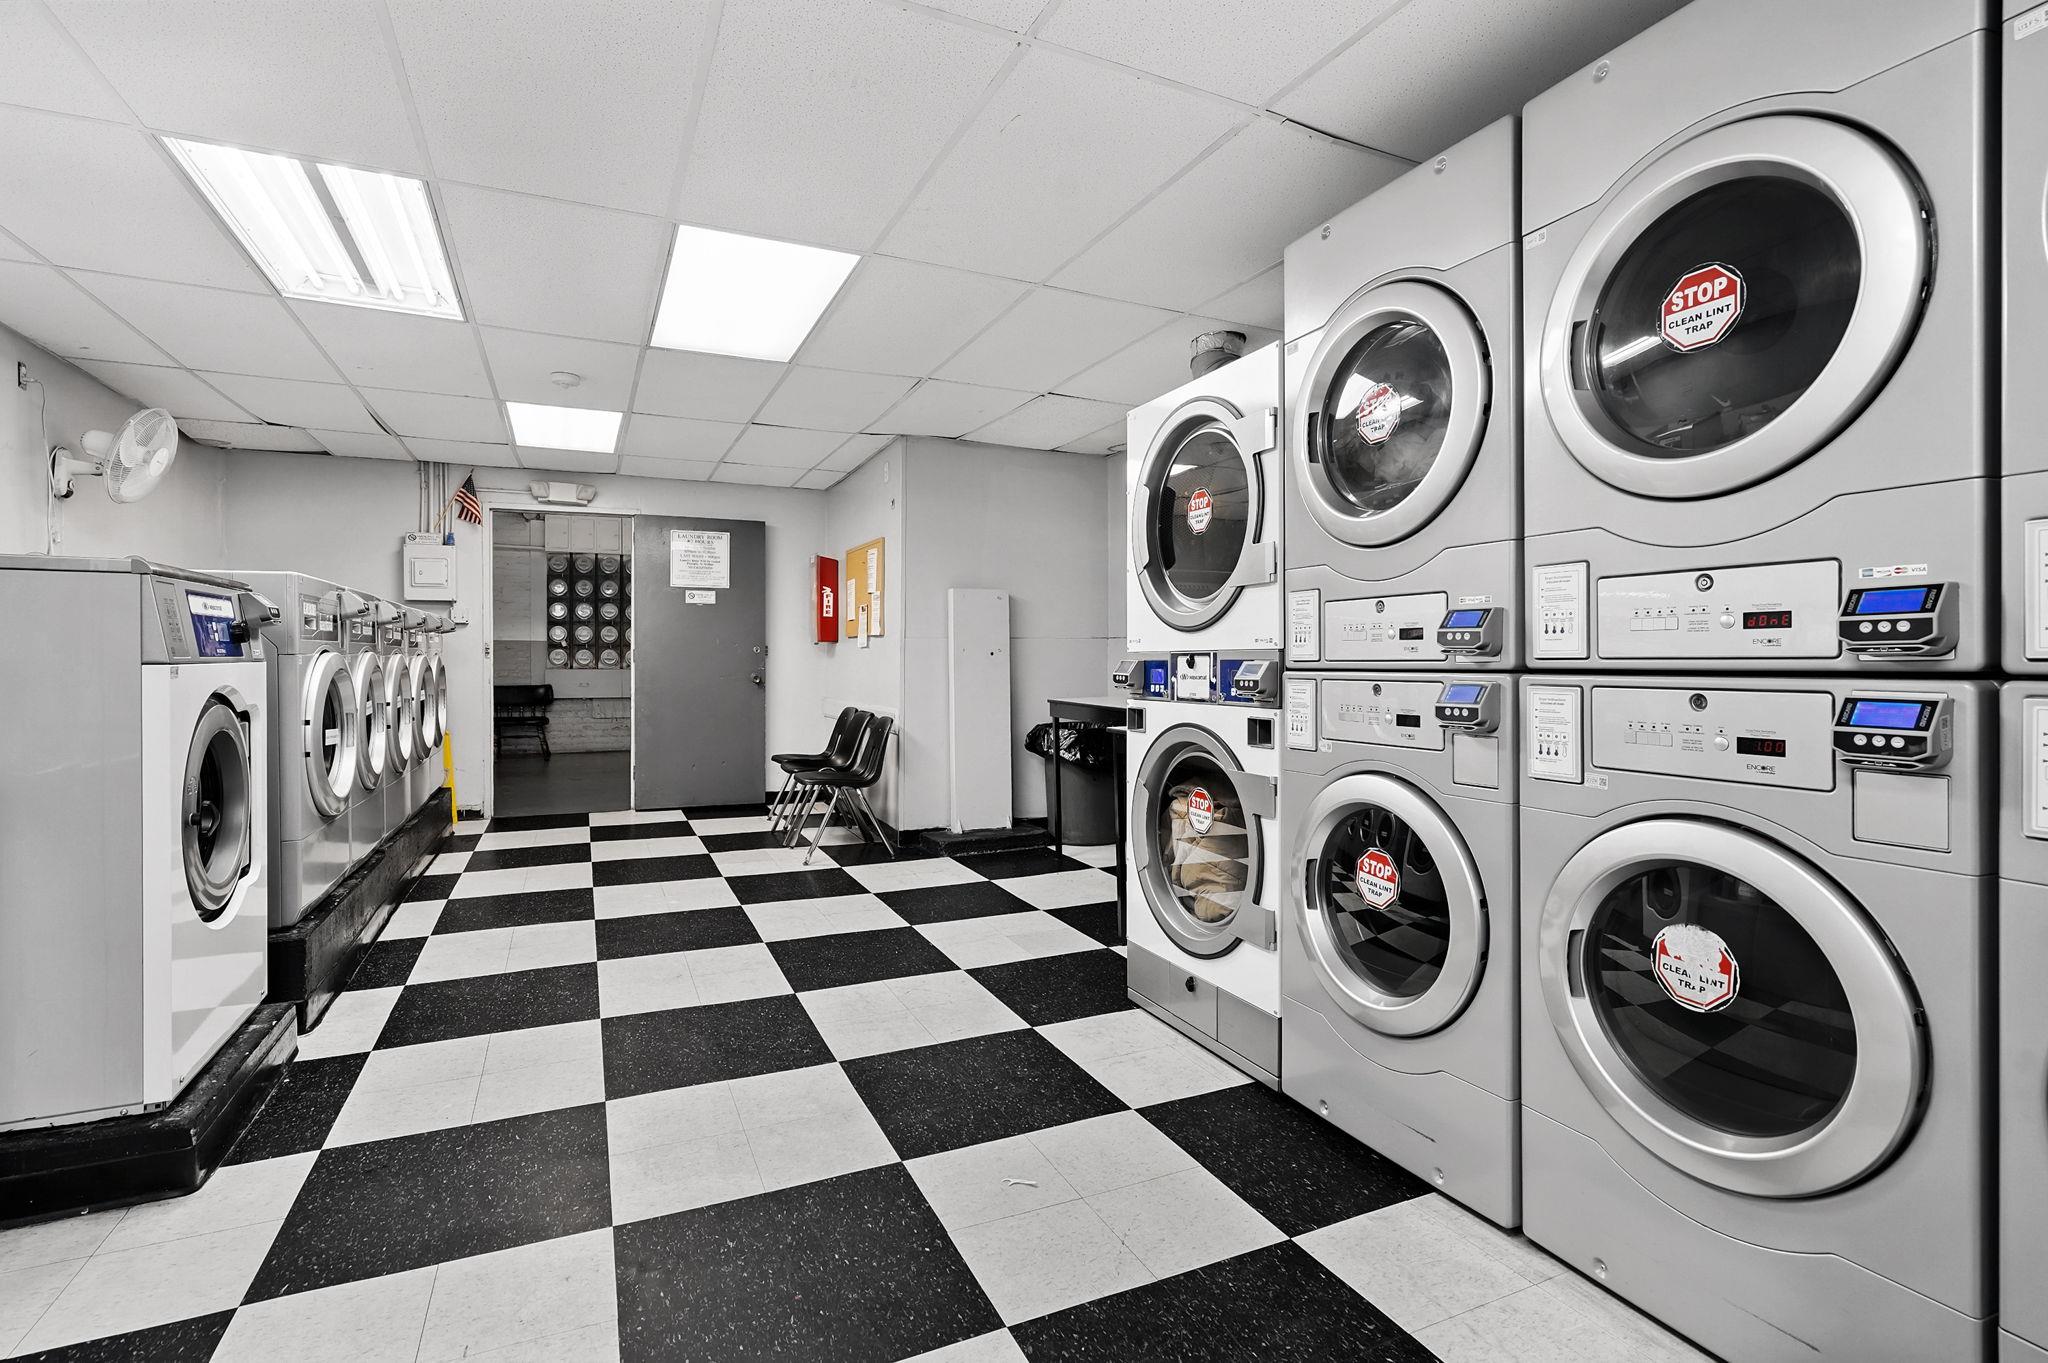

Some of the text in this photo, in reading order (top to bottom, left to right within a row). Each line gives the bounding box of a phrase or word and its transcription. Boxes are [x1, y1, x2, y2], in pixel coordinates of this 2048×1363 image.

[1671, 276, 1728, 312] STOP
[1668, 303, 1731, 330] CLEAN LINT
[1685, 320, 1713, 335] TRAP
[1190, 496, 1209, 511] STOP
[1191, 796, 1209, 811] STOP
[1362, 857, 1393, 880] STOP
[1360, 876, 1392, 894] CLEAN LINT
[1368, 887, 1382, 897] TRAP
[1662, 962, 1726, 989] CLEA LINT
